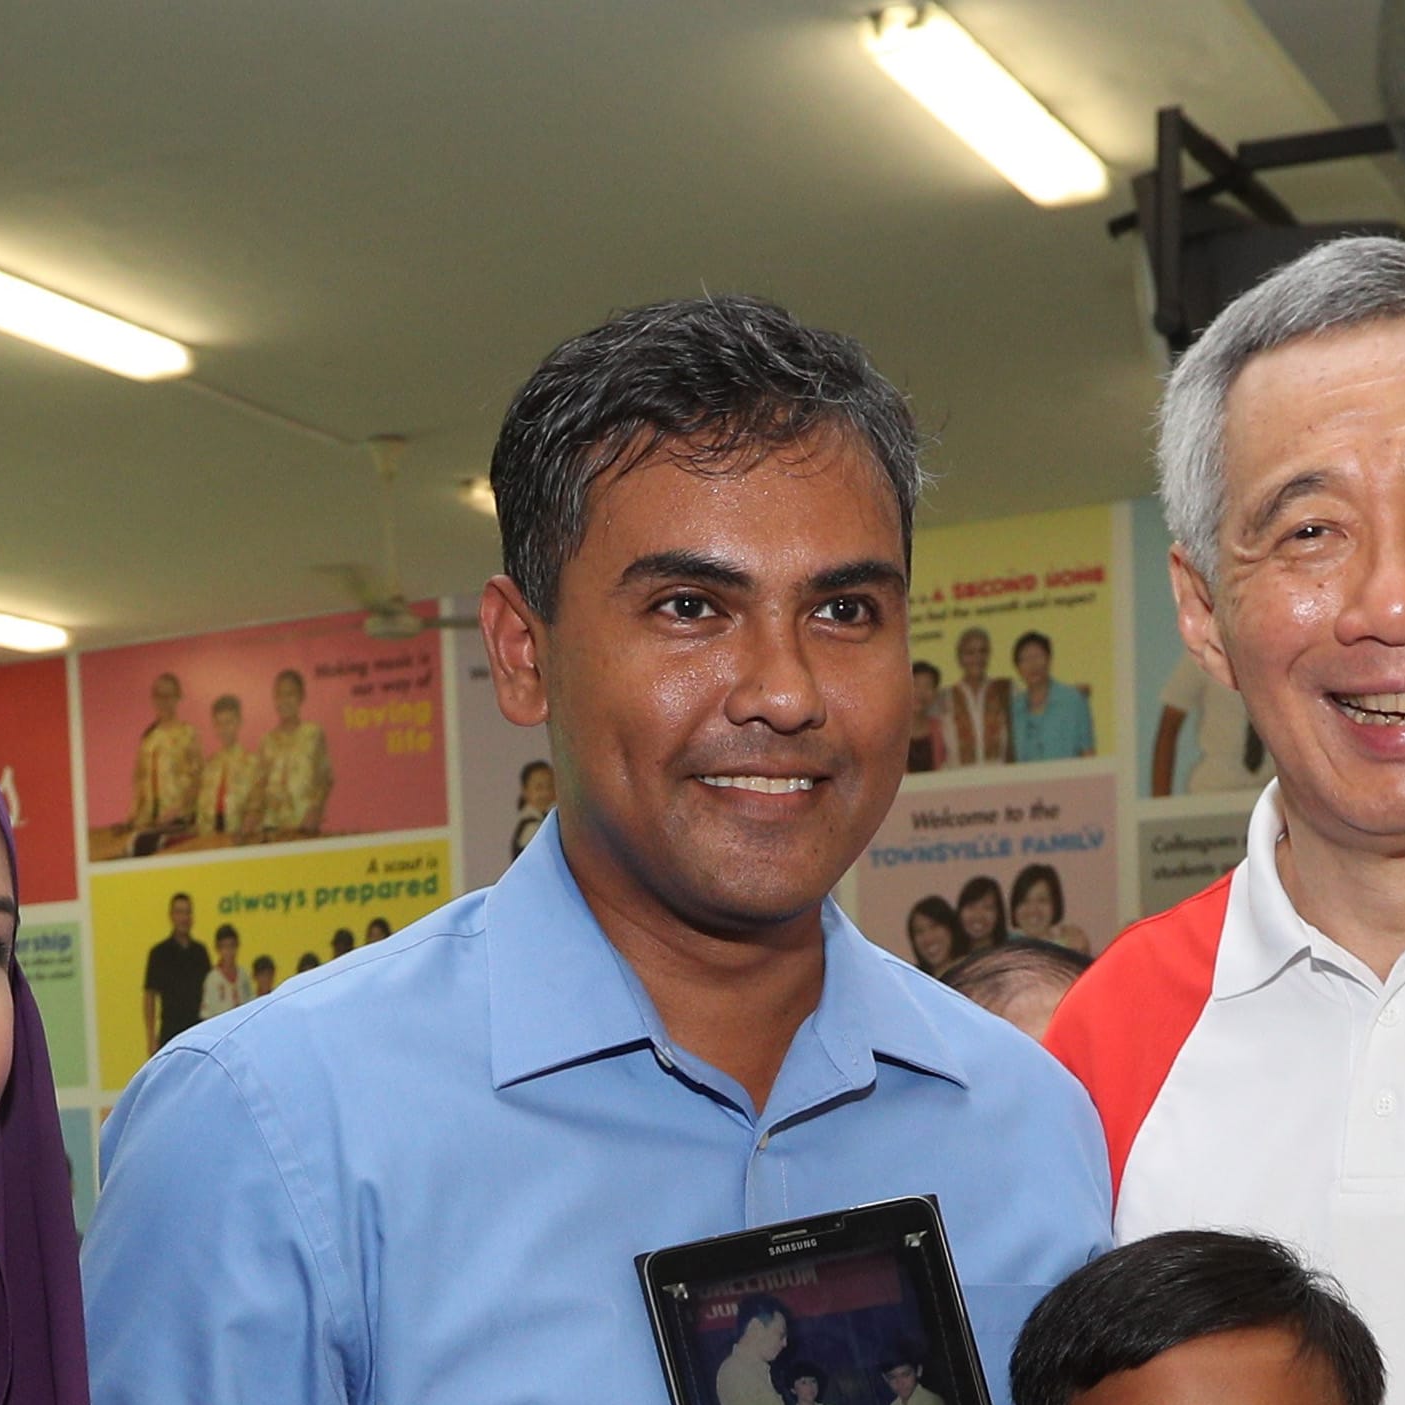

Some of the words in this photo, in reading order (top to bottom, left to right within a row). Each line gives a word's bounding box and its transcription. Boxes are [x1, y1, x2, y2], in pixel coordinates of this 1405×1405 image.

[911, 807, 1000, 831] Welcome
[1004, 804, 1024, 824] to
[1029, 797, 1060, 821] the
[366, 857, 378, 874] A
[384, 857, 422, 873] scout
[869, 836, 1012, 869] TOWNSVILLE
[1022, 829, 1107, 855] FAMILY
[218, 888, 306, 914] always
[314, 873, 438, 909] prepared
[768, 1238, 818, 1256] SAMSUNG
